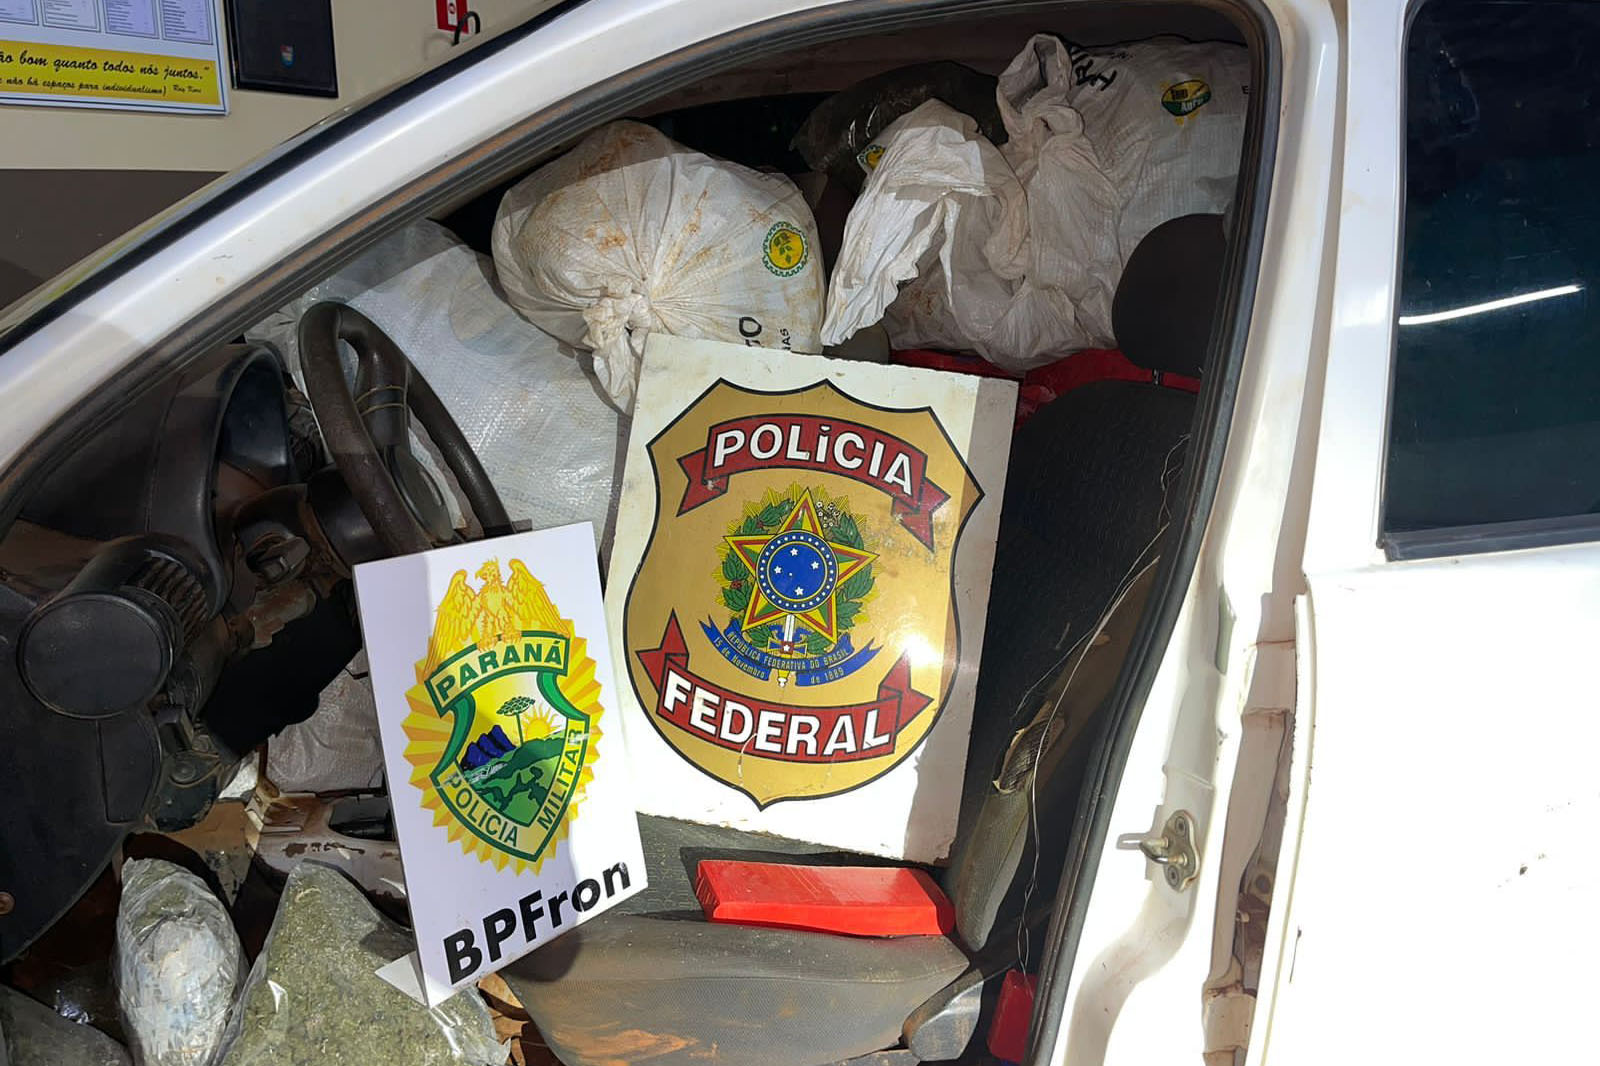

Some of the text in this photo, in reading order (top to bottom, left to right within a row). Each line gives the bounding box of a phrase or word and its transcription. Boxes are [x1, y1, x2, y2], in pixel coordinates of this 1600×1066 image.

[19, 49, 48, 66] bom
[54, 59, 98, 72] quanto
[103, 60, 135, 73] todos
[140, 64, 159, 75] nós
[79, 80, 99, 91] para
[713, 636, 722, 648] 15
[721, 646, 732, 658] de
[763, 655, 807, 671] FEDERATIVA
[810, 659, 820, 669] DO
[823, 648, 850, 666] BRASIL
[435, 640, 563, 702] PARANÁ
[810, 666, 845, 684] de 1889
[663, 669, 891, 756] FEDERAL
[536, 728, 583, 831] MILITAR
[443, 772, 519, 848] POLÍCIA
[443, 861, 631, 985] BPFron
